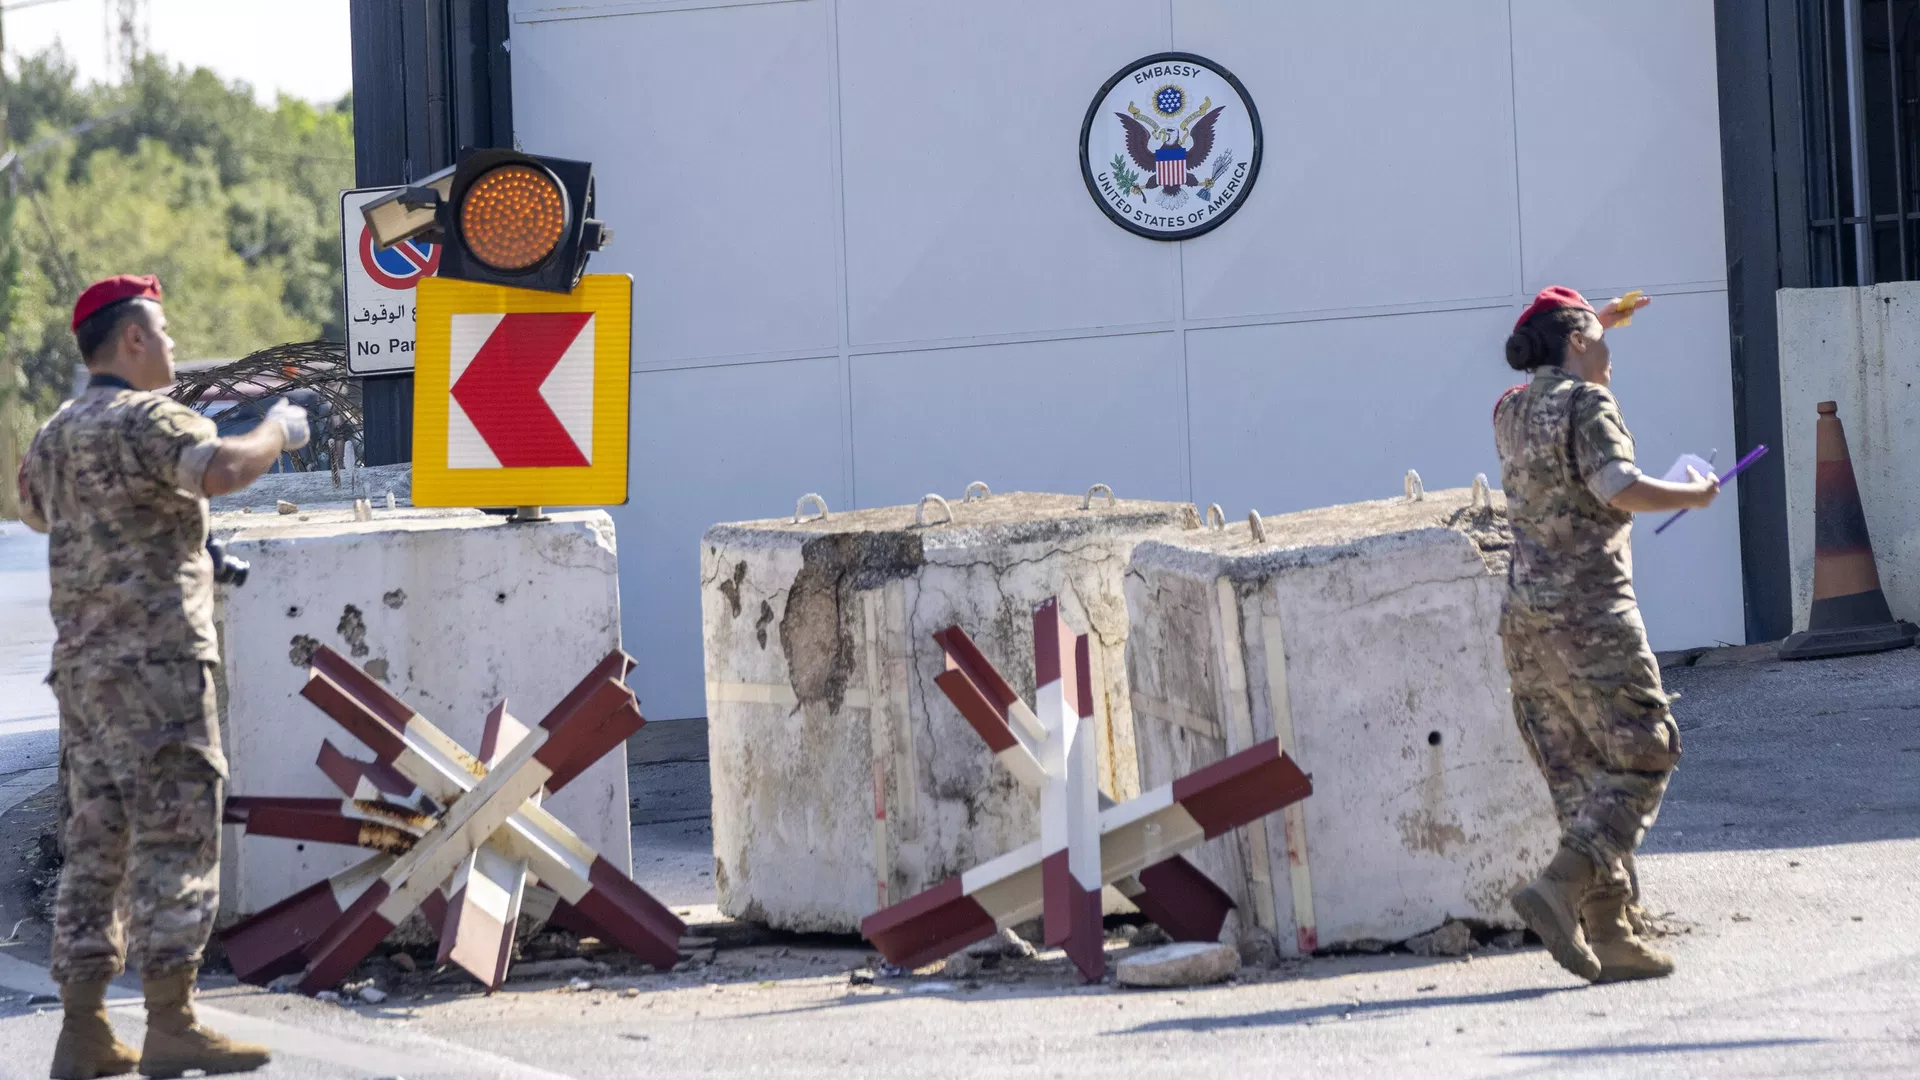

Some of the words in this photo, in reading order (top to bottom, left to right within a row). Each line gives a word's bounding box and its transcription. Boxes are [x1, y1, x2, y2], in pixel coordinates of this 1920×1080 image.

[1134, 65, 1201, 84] EMBASSY
[1098, 172, 1132, 214] UNITED
[1133, 210, 1185, 227] STATES
[1188, 209, 1204, 224] OF
[1208, 161, 1247, 215] AMERICA
[354, 304, 405, 325] الوقوف
[357, 341, 380, 356] No
[389, 338, 416, 353] Par
